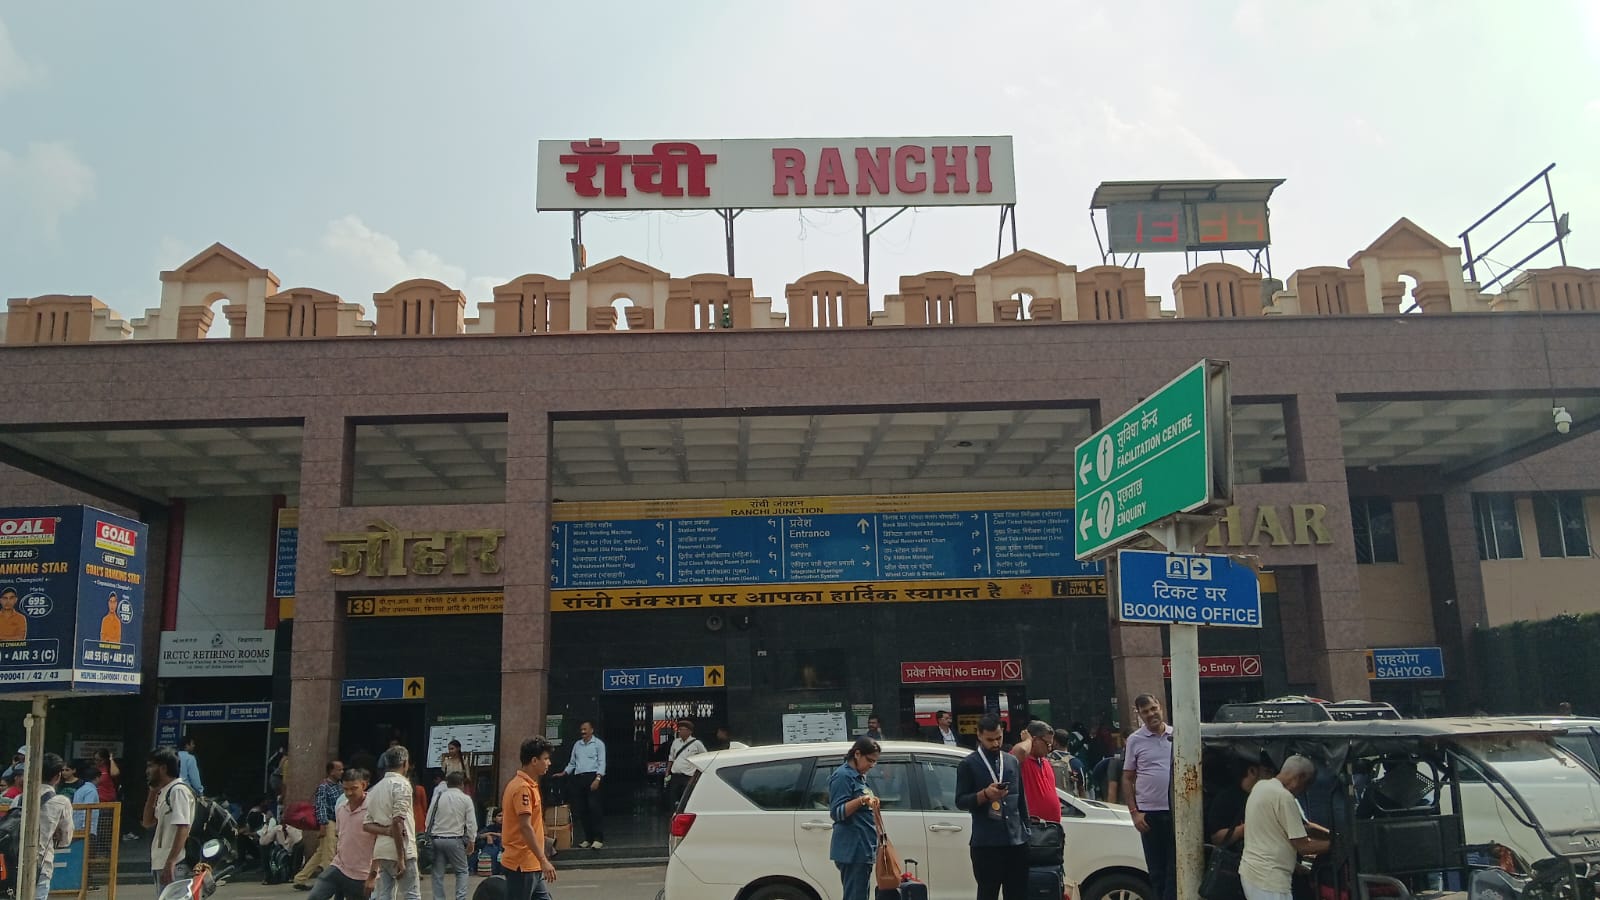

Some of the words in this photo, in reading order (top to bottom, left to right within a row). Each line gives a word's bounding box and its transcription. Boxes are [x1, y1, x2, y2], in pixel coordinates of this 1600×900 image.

[772, 145, 992, 195] RANCHI
[1136, 209, 1178, 243] 13
[1116, 420, 1139, 453] सुविधा
[1141, 408, 1158, 428] केन्द्र
[1116, 434, 1162, 470] FACILITATION
[1162, 413, 1193, 442] CENTRE
[1116, 478, 1144, 509] पूछताछ
[731, 508, 770, 516] RANCHI
[772, 507, 824, 515] JUNCTION
[1116, 501, 1147, 527] ENQUIRY
[789, 516, 812, 528] प्रवेश
[1205, 504, 1335, 547] HAR
[101, 525, 131, 544] GOAL
[789, 529, 830, 538] Entrance
[13, 550, 33, 558] 2026
[324, 519, 506, 577] जोहार
[41, 562, 68, 574] STAR
[562, 591, 613, 609] रांची
[619, 591, 702, 607] जंक्शन
[709, 592, 737, 605] पर
[745, 590, 823, 604] आपका
[830, 585, 898, 602] हार्दिक
[904, 586, 981, 599] स्वागत
[986, 582, 1002, 598] है
[1069, 587, 1089, 595] DIAL
[1152, 579, 1198, 600] टिकट
[1203, 587, 1228, 602] घर
[28, 596, 46, 605] 695
[347, 598, 374, 614] 139
[27, 607, 46, 615] 720
[1123, 602, 1197, 620] BOOKING
[1201, 606, 1257, 623] OFFICE
[11, 650, 30, 661] AIR
[32, 649, 39, 660] 3
[41, 649, 56, 662] (C)
[84, 650, 94, 660] AIR
[113, 652, 122, 663] AIR
[163, 650, 190, 661] IRCTC
[193, 649, 236, 660] RETIRING
[238, 649, 271, 659] ROOMS
[1375, 650, 1420, 667] सहयोग
[905, 665, 926, 679] प्रवेश
[928, 665, 952, 677] निषेध
[955, 668, 969, 677] No
[971, 667, 996, 678] Entry
[1210, 663, 1236, 673] Entry
[1377, 666, 1432, 678] SAHYOG
[33, 671, 42, 680] 42
[49, 671, 59, 679] 43
[610, 670, 641, 686] प्रवेश
[648, 674, 683, 687] Entry
[346, 686, 382, 698] Entry
